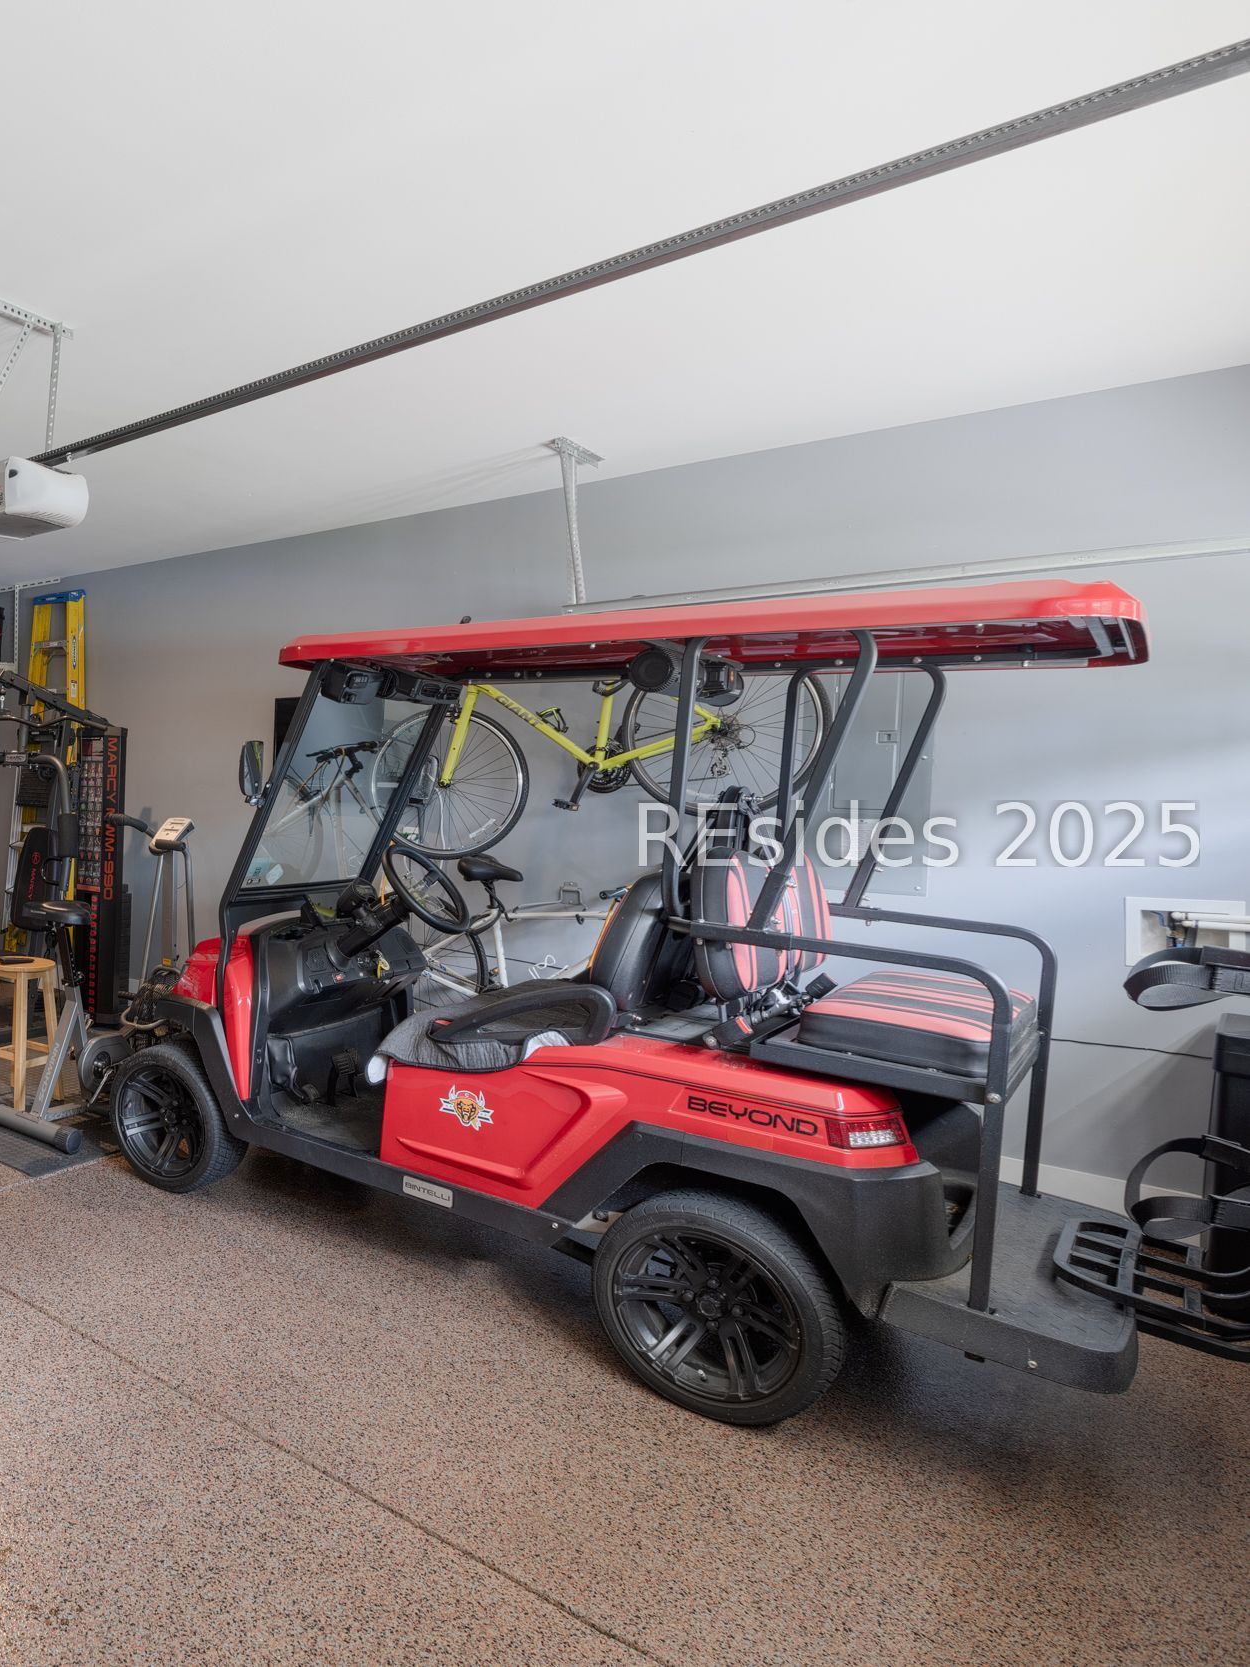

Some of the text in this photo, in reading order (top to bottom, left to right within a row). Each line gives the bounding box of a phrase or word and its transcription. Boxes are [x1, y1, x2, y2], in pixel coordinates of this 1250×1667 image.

[496, 695, 543, 726] GIANT
[105, 737, 118, 804] MARCY
[37, 1041, 60, 1103] SCHWINN
[687, 1096, 819, 1136] BEYOND
[404, 1181, 452, 1202] BINTELLI
